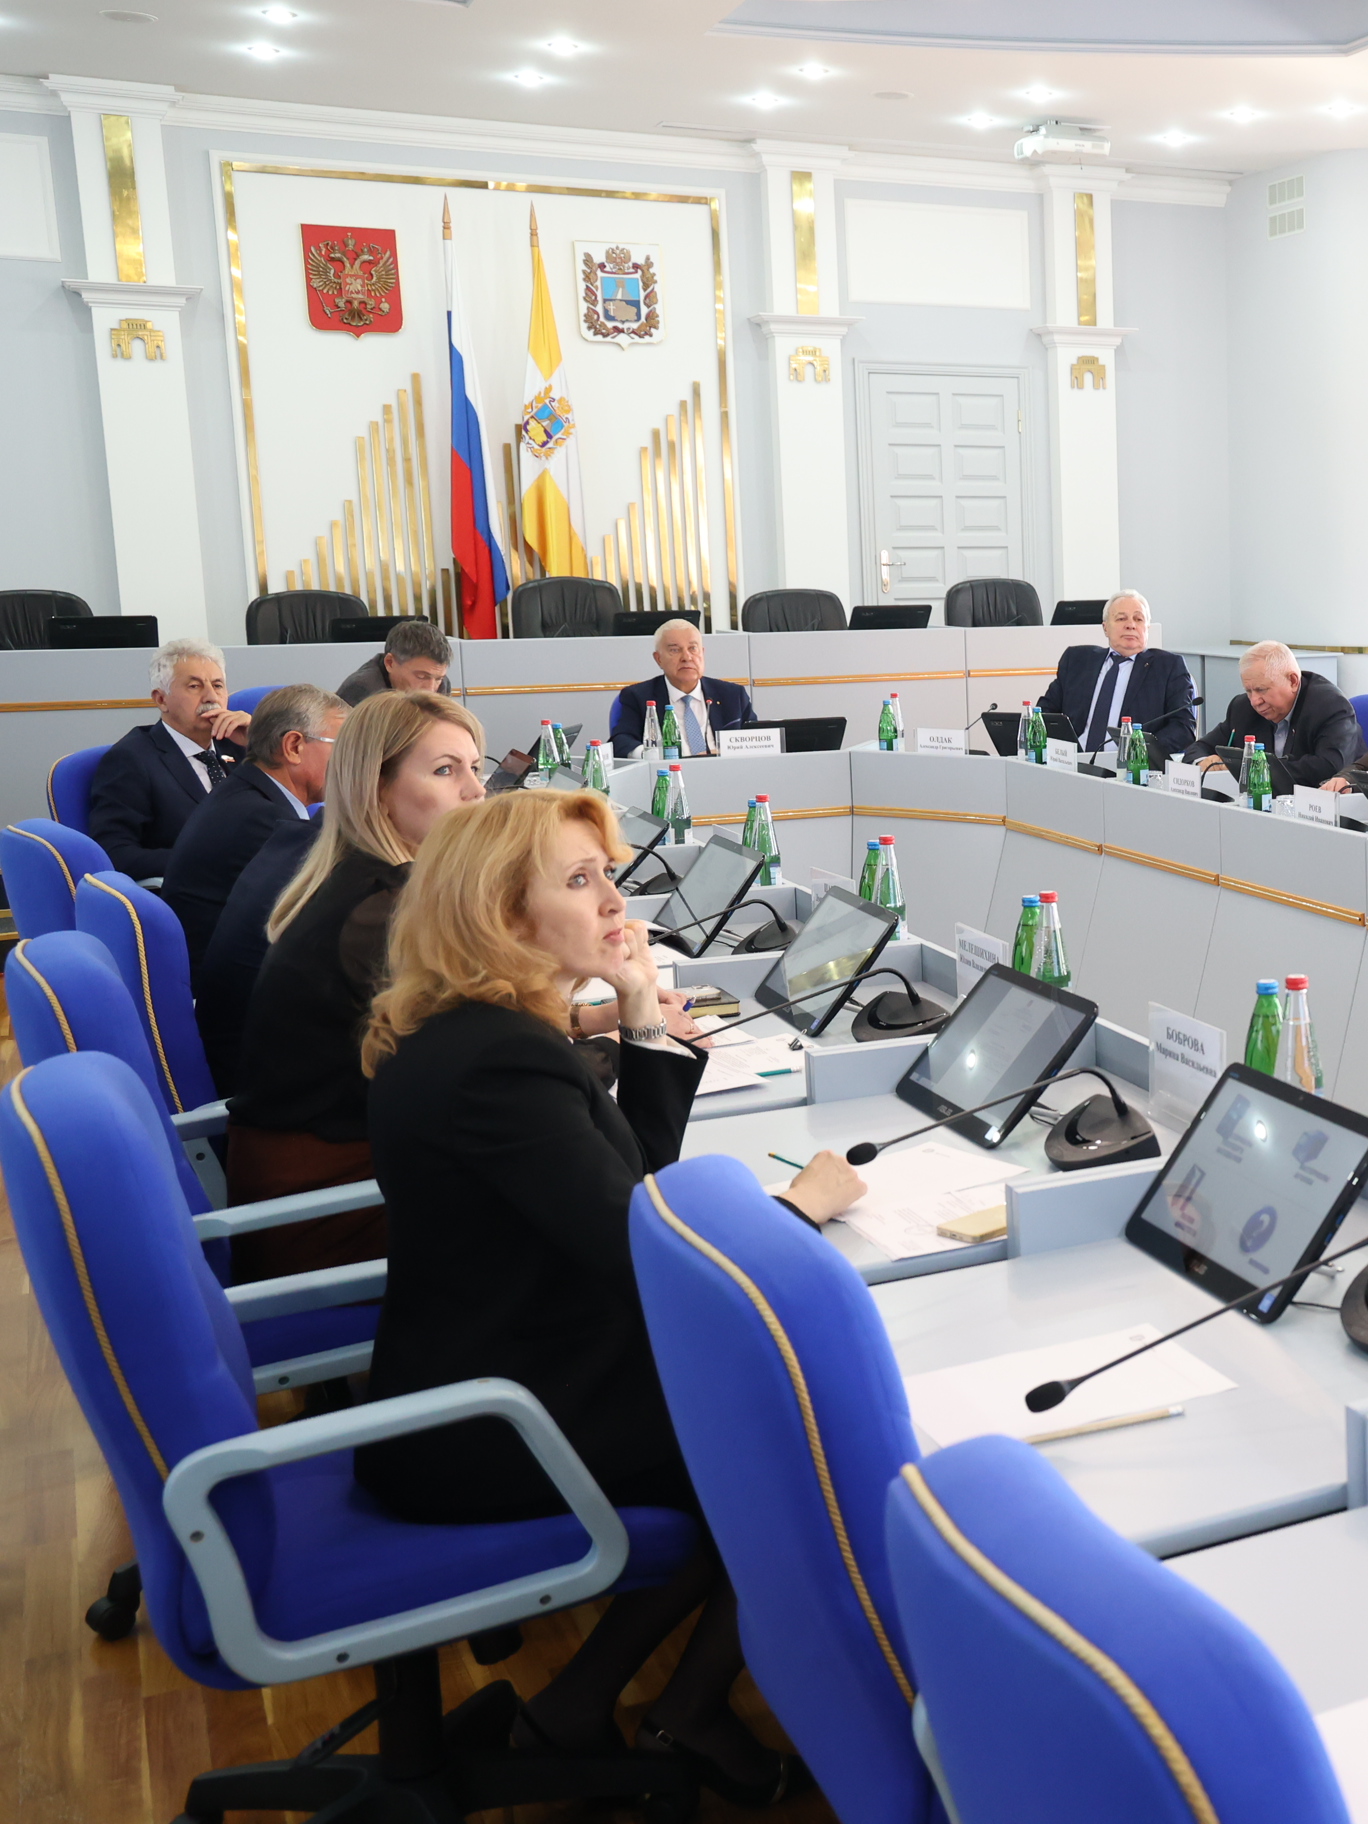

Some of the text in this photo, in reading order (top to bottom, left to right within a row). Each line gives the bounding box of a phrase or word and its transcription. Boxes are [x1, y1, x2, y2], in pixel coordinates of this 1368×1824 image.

[729, 735, 772, 744] СКВОРЦОВ
[929, 736, 953, 744] ОЛДАК
[1308, 803, 1322, 814] РОЕВ
[1166, 1026, 1205, 1055] БОБРОВА
[1155, 1041, 1217, 1078] Марина Васильевна
